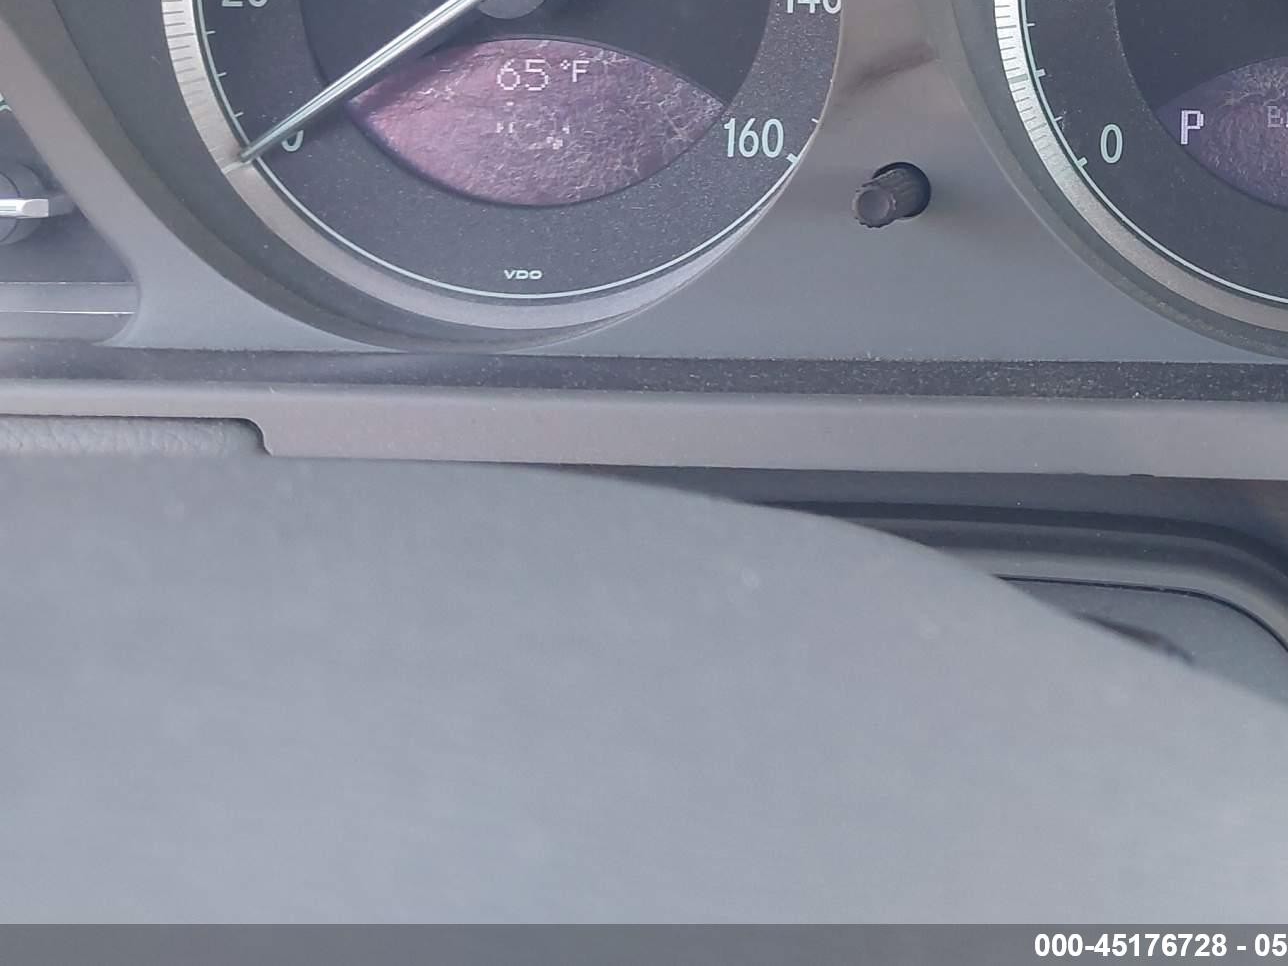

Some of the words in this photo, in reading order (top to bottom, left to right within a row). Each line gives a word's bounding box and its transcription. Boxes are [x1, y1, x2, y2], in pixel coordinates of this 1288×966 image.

[496, 58, 549, 91] 65
[723, 117, 784, 158] 160
[1100, 123, 1123, 164] 0
[1180, 110, 1204, 145] P
[503, 269, 543, 280] VDO
